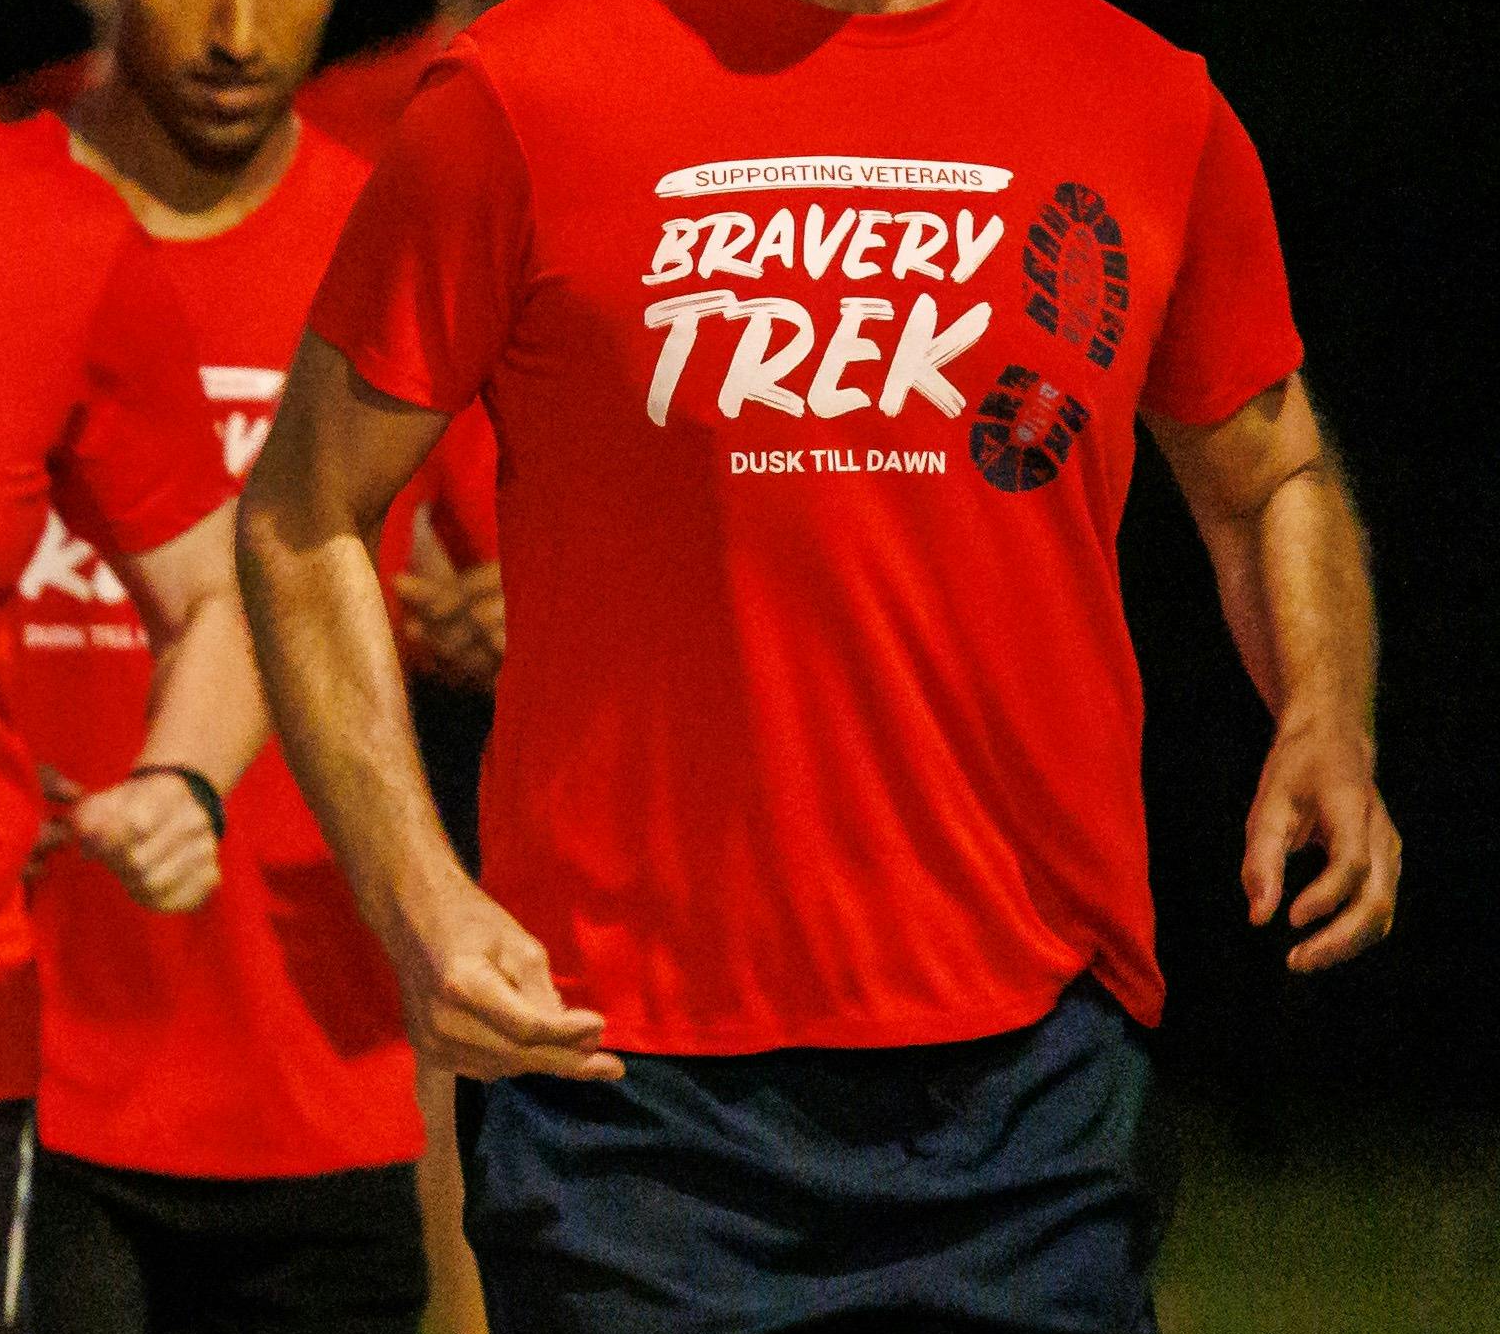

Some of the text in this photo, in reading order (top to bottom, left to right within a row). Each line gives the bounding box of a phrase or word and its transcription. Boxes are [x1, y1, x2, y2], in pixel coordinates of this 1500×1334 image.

[695, 164, 983, 187] SUPPORTING VETERANS
[642, 204, 1005, 285] BRAVERY
[645, 290, 992, 426] TREK
[730, 449, 946, 474] DUSK TILL DAWN
